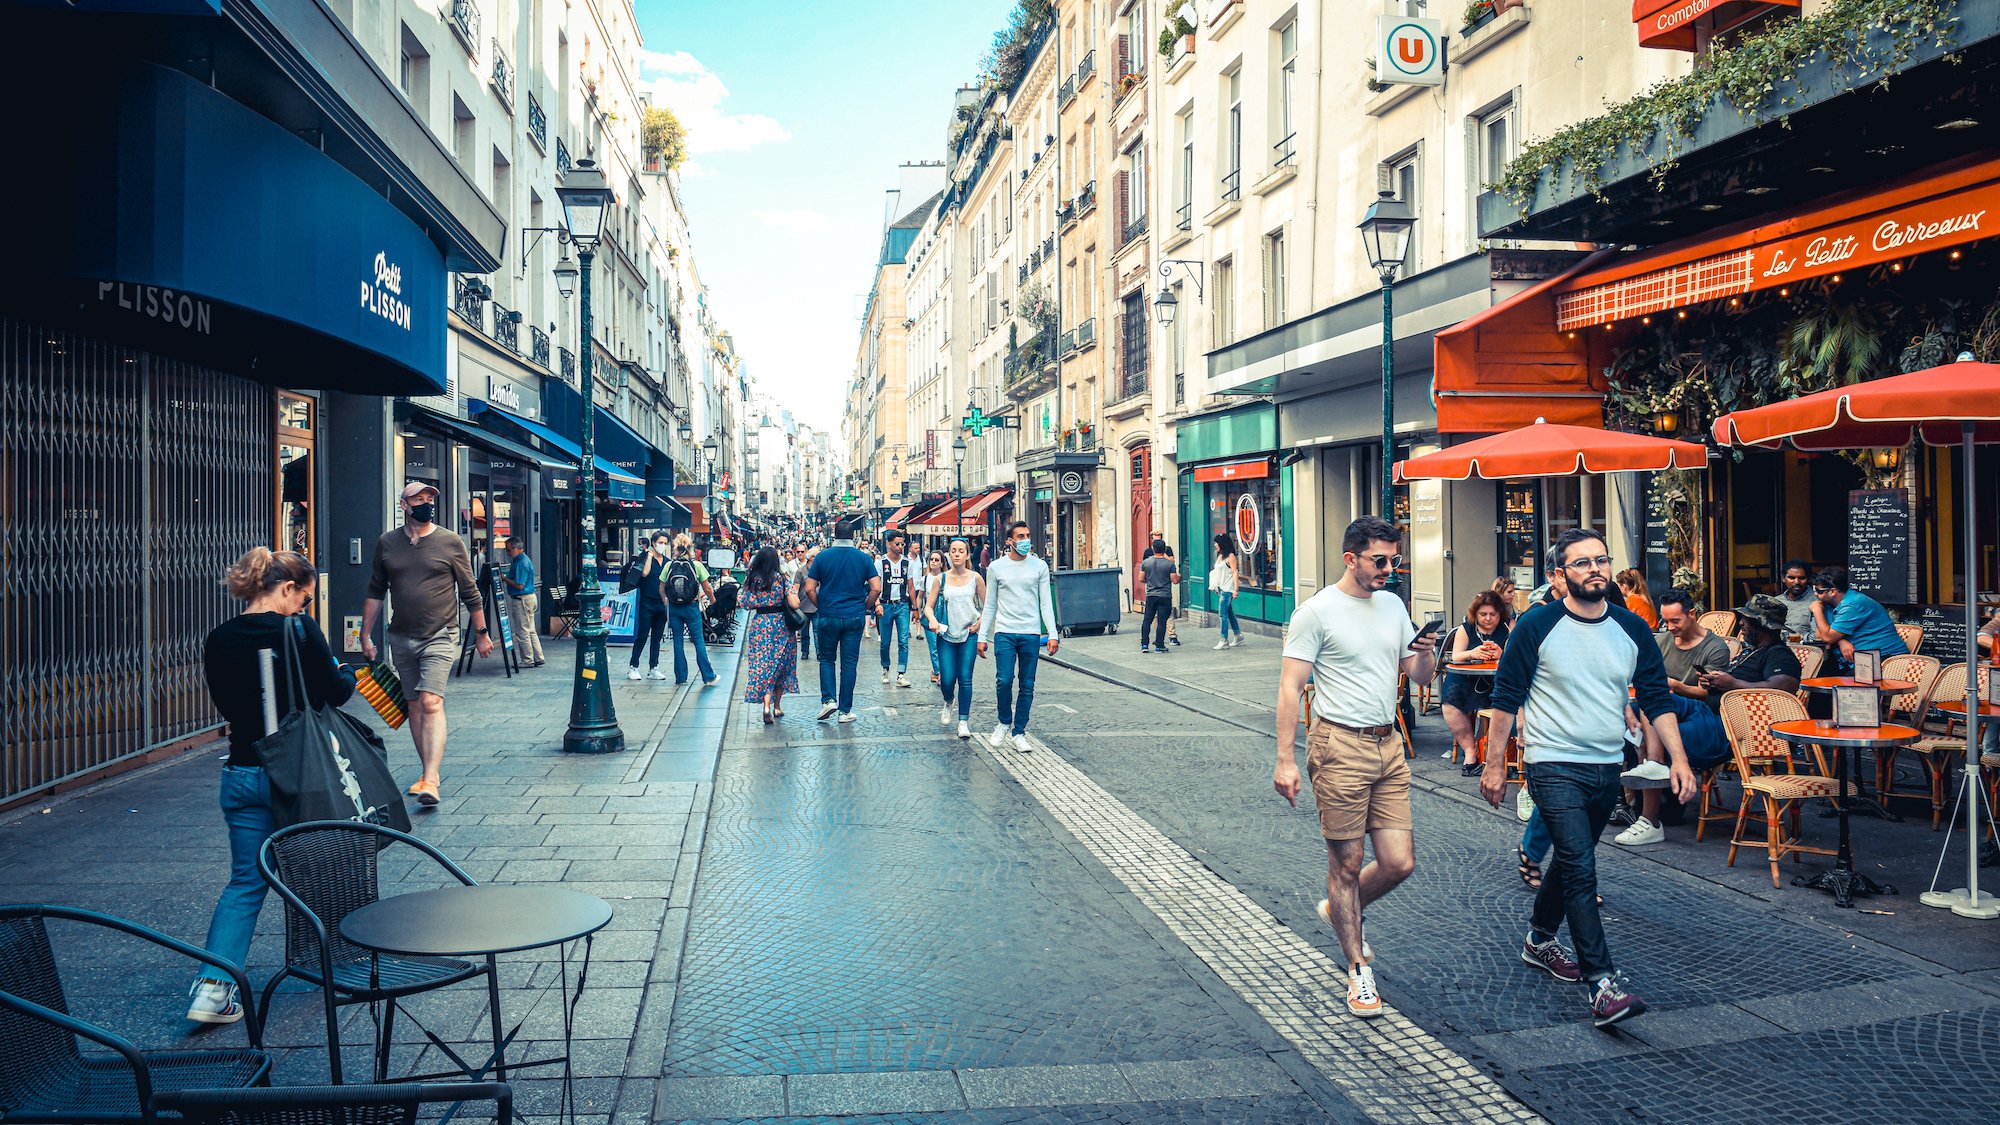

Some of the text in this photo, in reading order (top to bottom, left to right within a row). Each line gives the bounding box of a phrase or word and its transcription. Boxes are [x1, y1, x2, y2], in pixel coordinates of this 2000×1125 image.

[1398, 37, 1424, 63] U
[1763, 210, 1986, 277] Les Petits Carreaux
[374, 250, 401, 296] Petit
[98, 281, 210, 335] PLISSON
[361, 280, 411, 331] PLISSON
[488, 375, 520, 411] Leonidas
[887, 577, 904, 585] Jeep
